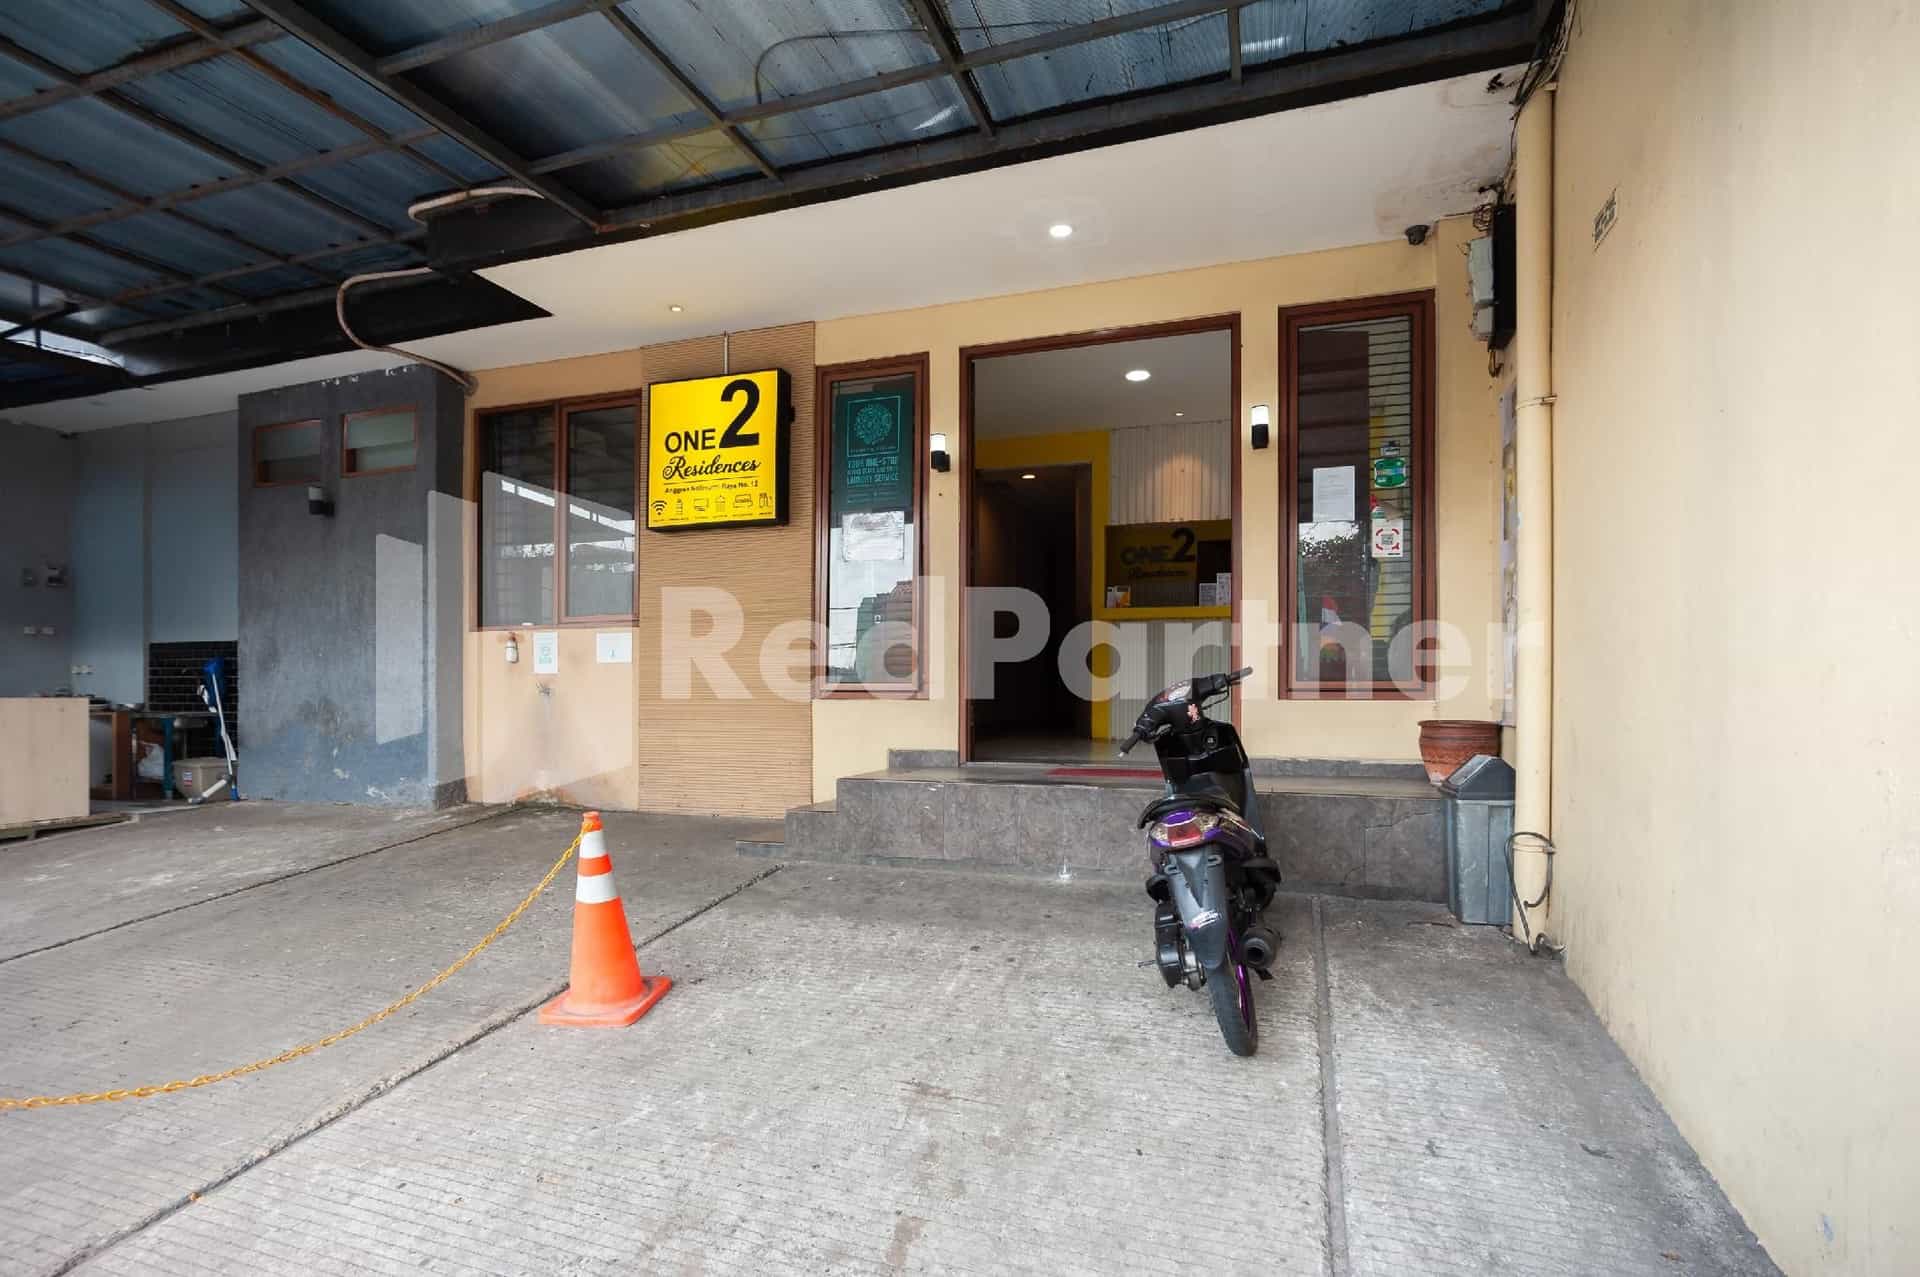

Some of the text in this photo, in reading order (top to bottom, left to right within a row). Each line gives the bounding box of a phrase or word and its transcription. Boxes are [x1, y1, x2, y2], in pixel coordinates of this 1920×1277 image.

[664, 379, 760, 453] ONE 2
[663, 454, 761, 480] Residences
[1171, 527, 1196, 562] 2
